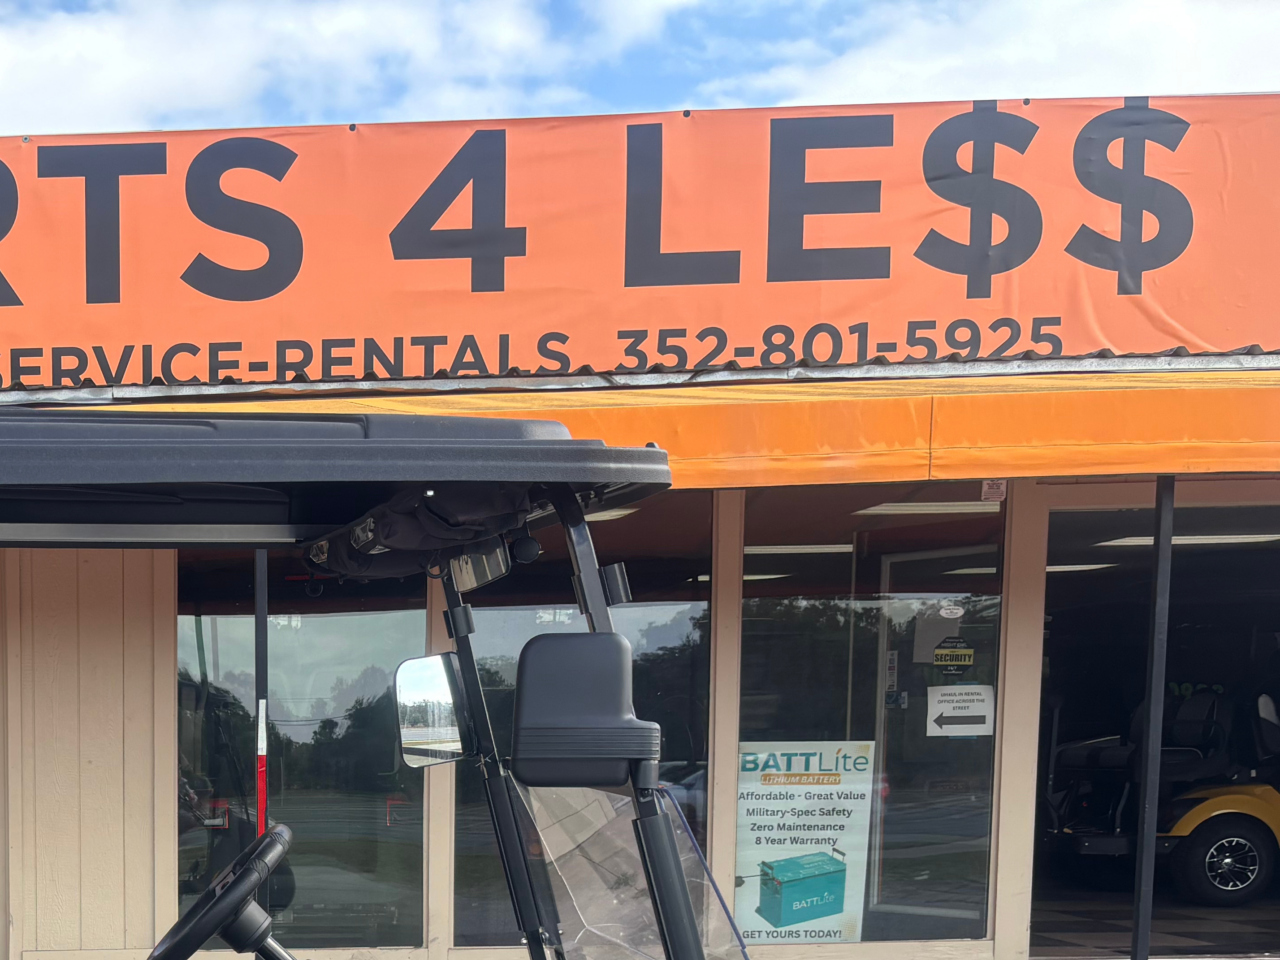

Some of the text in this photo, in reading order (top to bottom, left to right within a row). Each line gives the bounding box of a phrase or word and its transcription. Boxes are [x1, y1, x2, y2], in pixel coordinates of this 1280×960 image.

[389, 129, 527, 293] 4
[623, 96, 1195, 300] LE$$
[614, 316, 1064, 371] 352-801-5925
[934, 653, 972, 662] SECURITY
[761, 775, 841, 784] LITHIUM BATTERY
[738, 792, 795, 801] Affordable
[804, 791, 834, 800] Great
[836, 791, 866, 800] Value
[746, 807, 853, 818] Military-Spec Safety
[750, 822, 845, 831] Zero Maintenance
[755, 836, 838, 847] 8 Year Warranty
[742, 929, 842, 939] GET YOURS TODAY!
